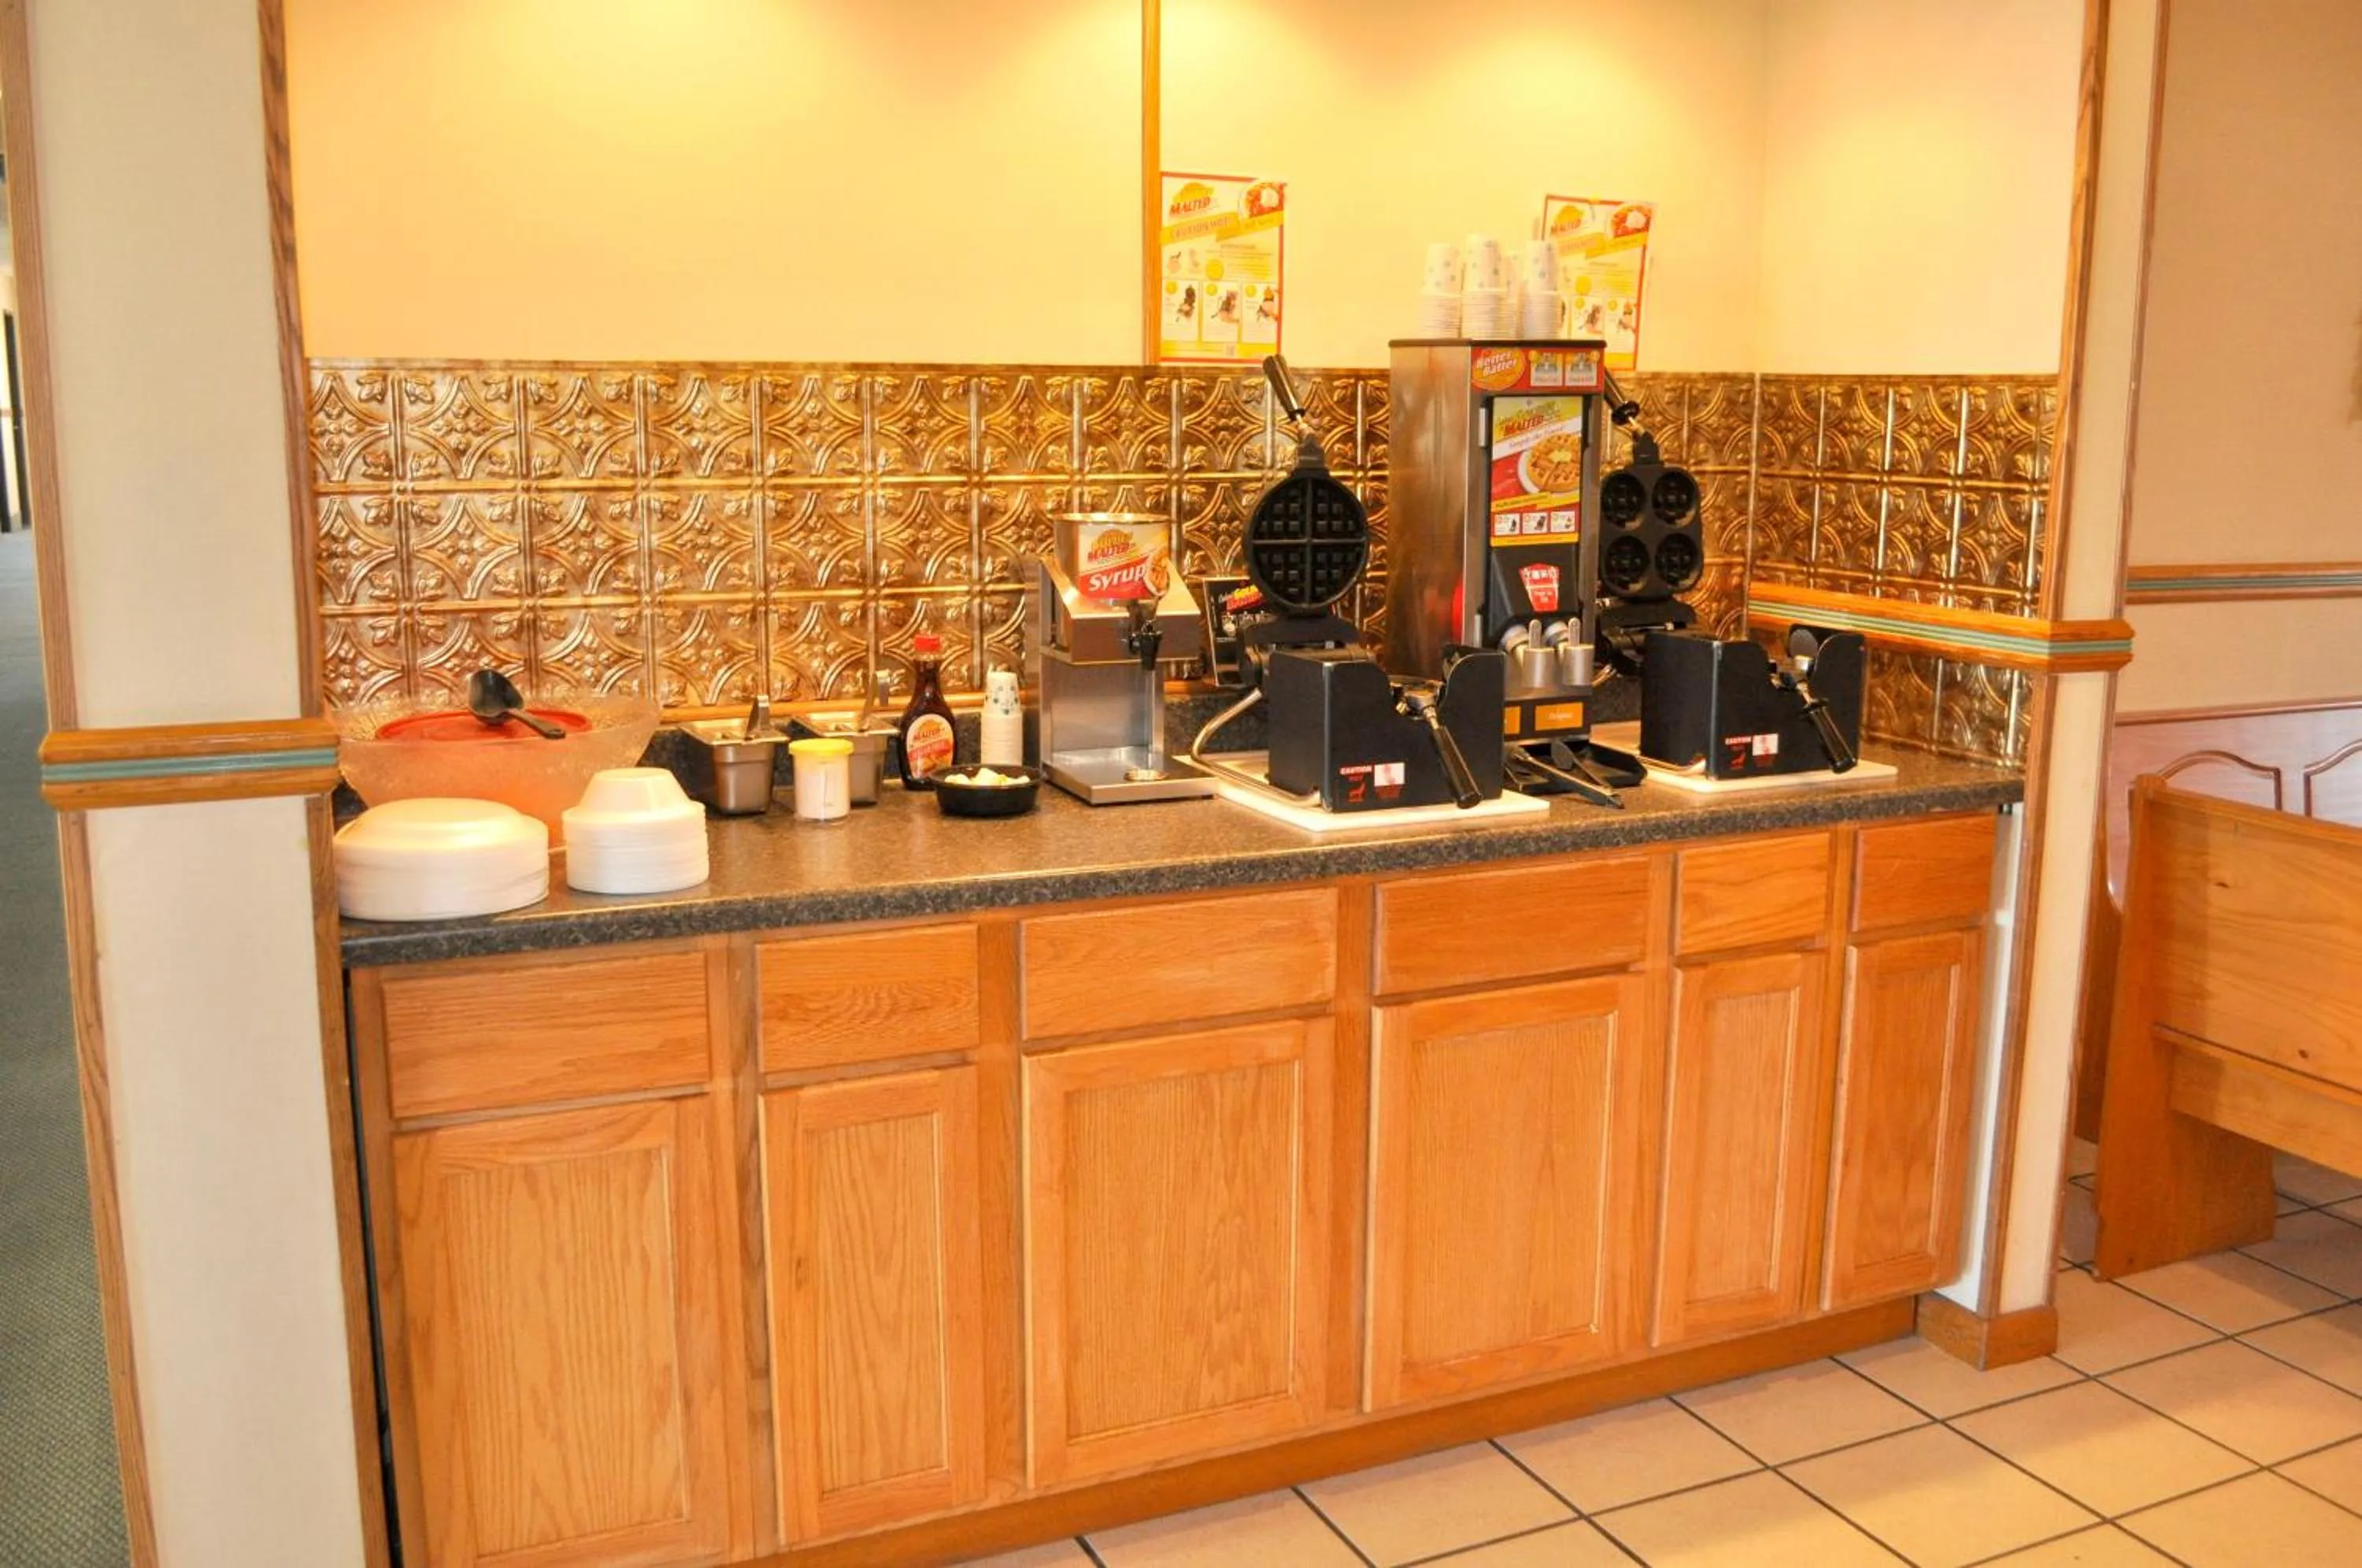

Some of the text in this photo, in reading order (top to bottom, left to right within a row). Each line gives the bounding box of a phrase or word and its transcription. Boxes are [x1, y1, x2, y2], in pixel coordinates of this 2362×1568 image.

[1169, 197, 1211, 215] MALTED
[1089, 563, 1146, 592] Syrup
[1340, 765, 1372, 775] CAUTION
